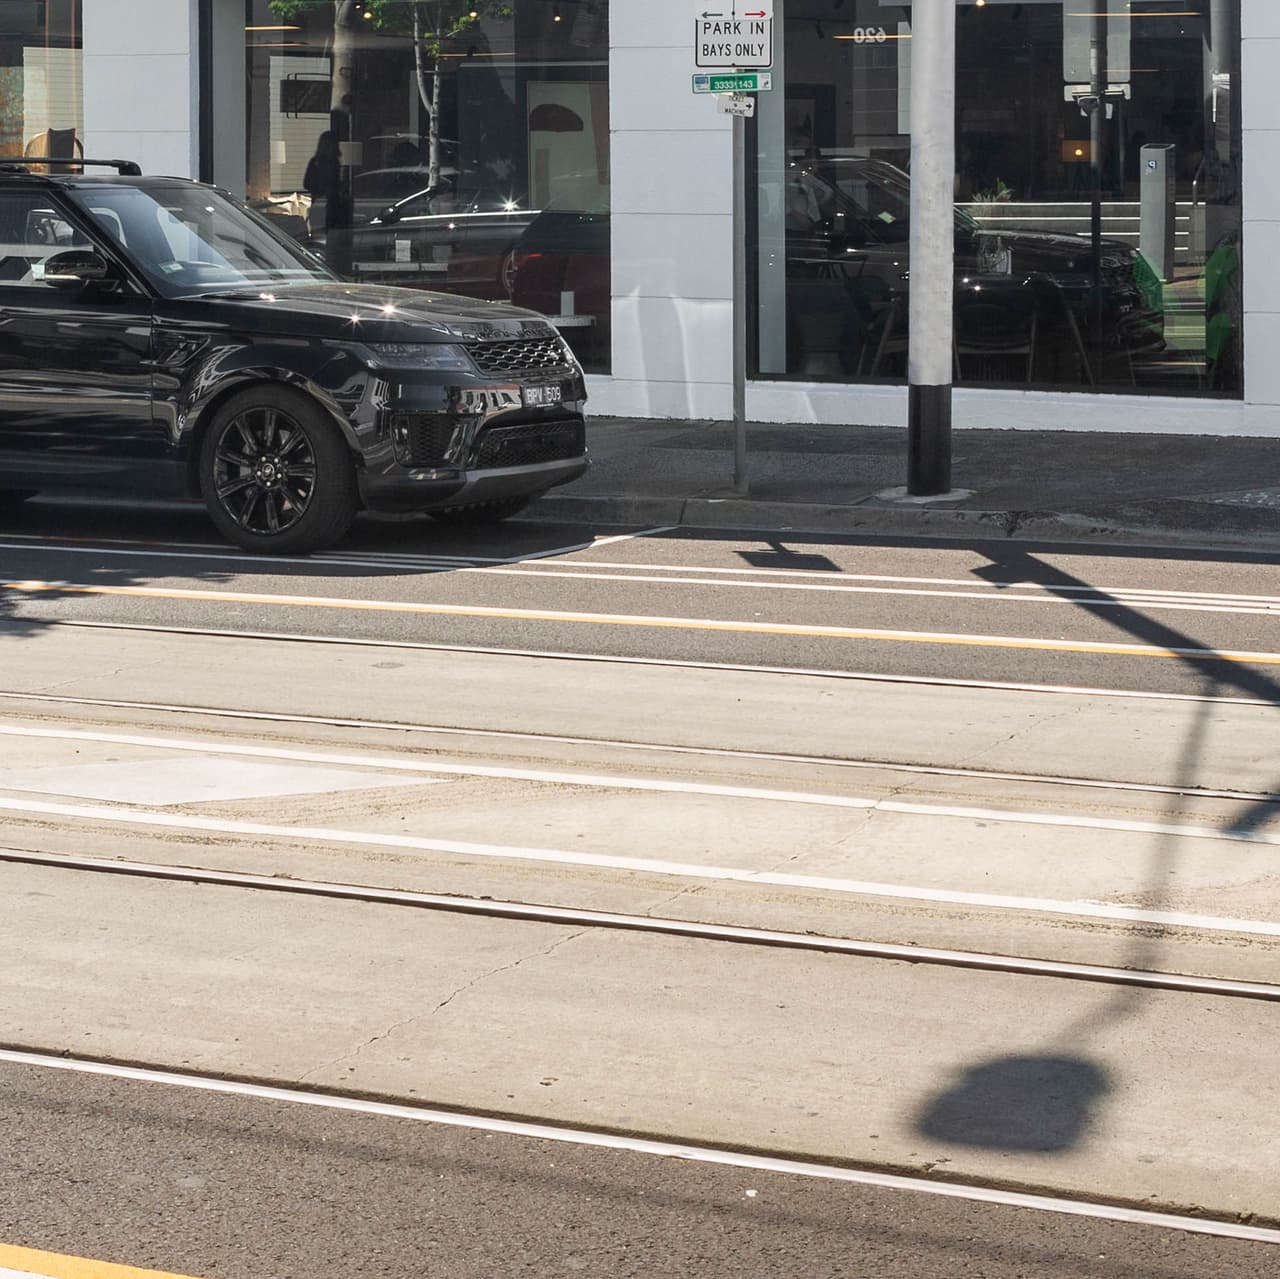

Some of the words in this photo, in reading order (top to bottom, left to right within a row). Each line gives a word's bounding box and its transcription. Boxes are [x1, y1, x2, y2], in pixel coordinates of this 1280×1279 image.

[704, 22, 741, 35] PARK
[750, 22, 764, 35] IN
[702, 44, 731, 57] BAYS
[735, 44, 765, 57] ONLY
